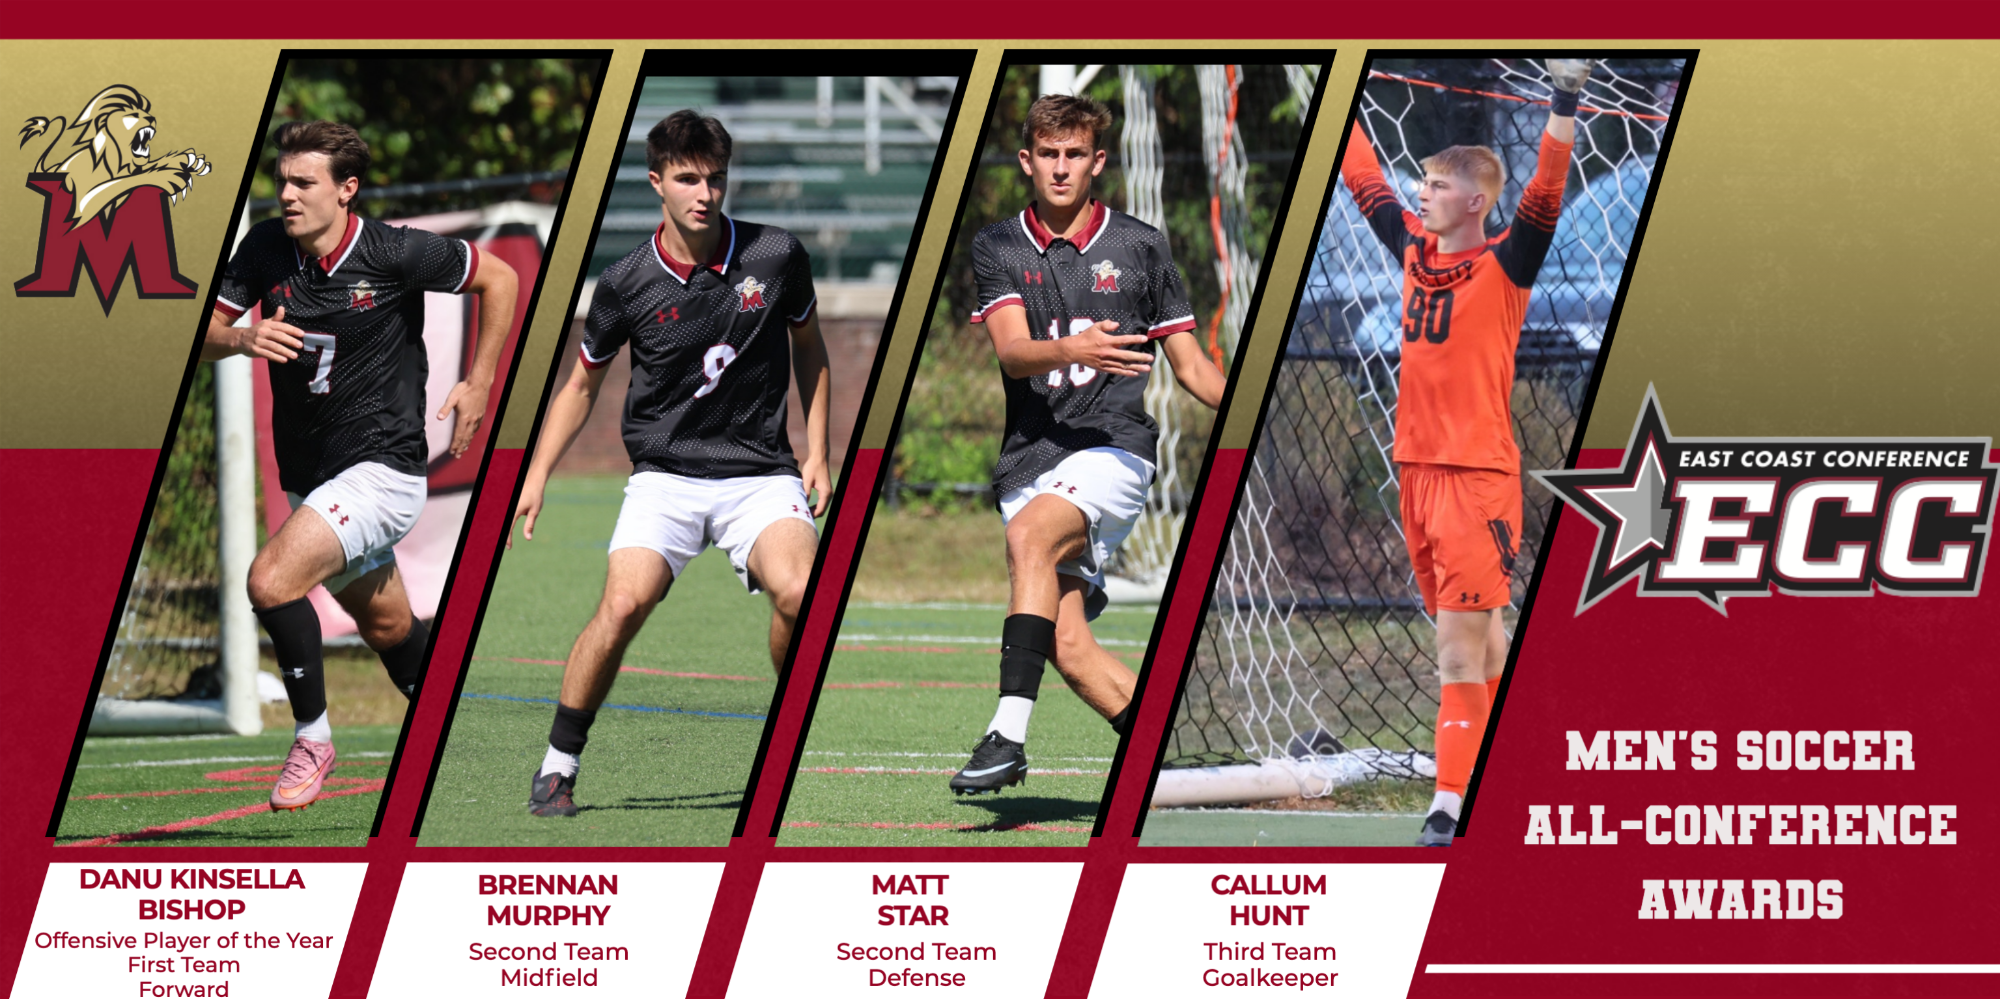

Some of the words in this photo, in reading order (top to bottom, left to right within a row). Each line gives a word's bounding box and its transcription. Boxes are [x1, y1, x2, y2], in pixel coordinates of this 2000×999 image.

[1404, 286, 1455, 344] 90
[303, 331, 336, 394] 7
[693, 343, 738, 400] 9
